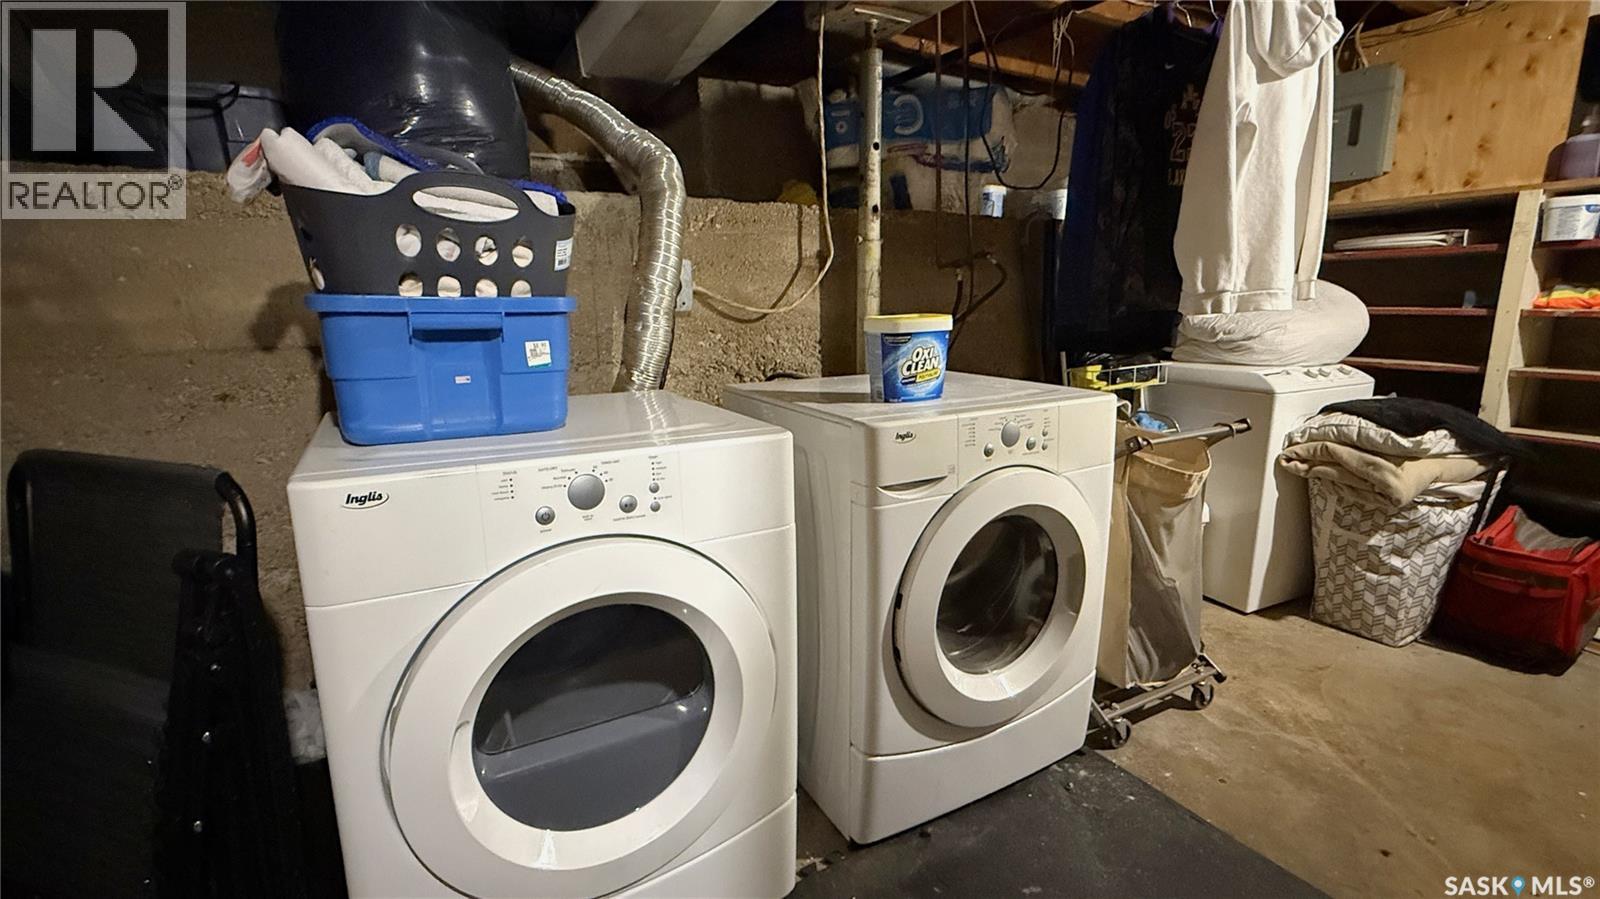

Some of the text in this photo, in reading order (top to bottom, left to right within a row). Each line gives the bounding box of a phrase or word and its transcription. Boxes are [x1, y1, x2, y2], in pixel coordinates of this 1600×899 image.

[912, 346, 934, 360] OXI
[902, 356, 939, 376] CLEAN
[895, 431, 914, 442] Inglis
[345, 491, 383, 506] Inglis
